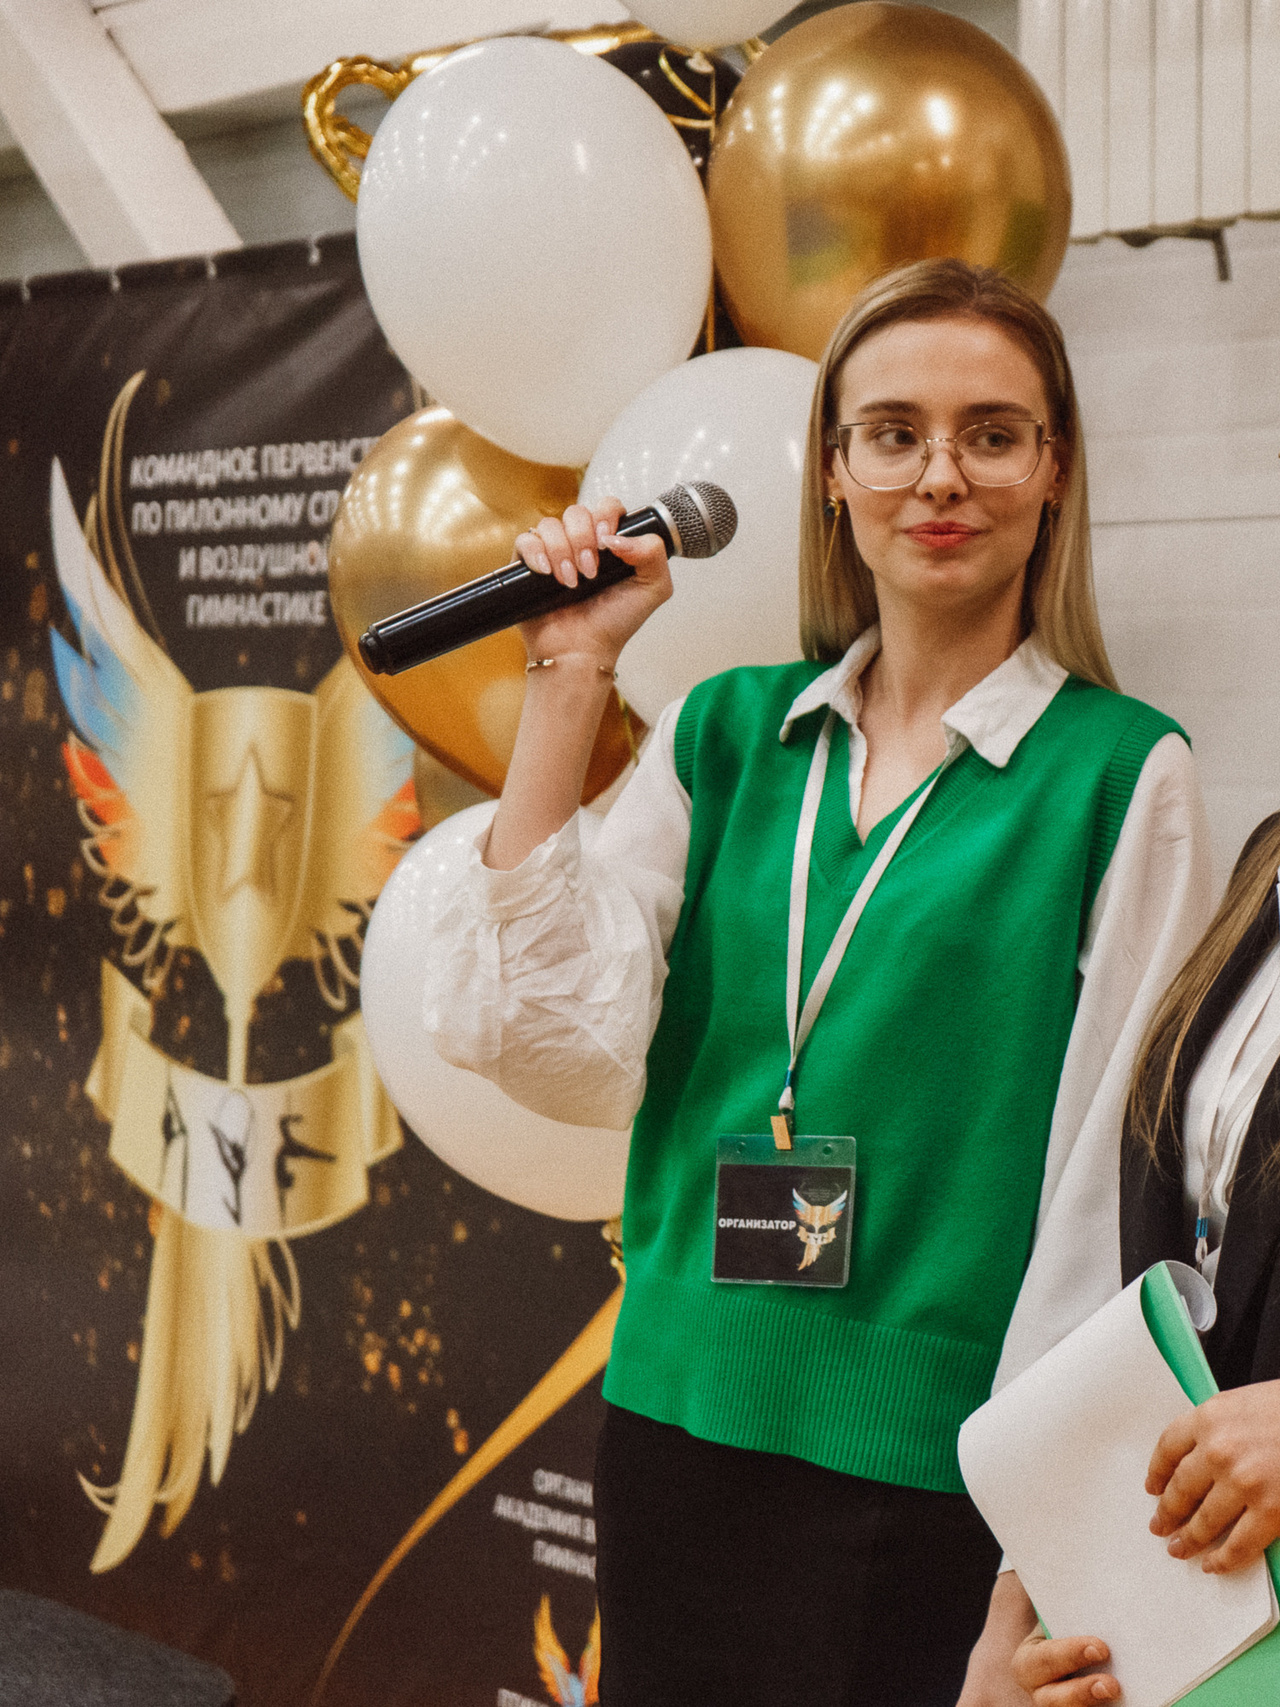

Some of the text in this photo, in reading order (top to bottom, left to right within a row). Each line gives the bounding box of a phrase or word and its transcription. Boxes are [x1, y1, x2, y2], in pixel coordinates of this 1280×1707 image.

[130, 446, 258, 488] КОМАНДНОЕ
[132, 500, 162, 535] ПО
[164, 492, 305, 533] ПИЛОННОМУ
[178, 546, 196, 581] И
[186, 590, 327, 627] ГИМНАСТИКЕ
[718, 1218, 796, 1230] ОРГАНИЗАТОР
